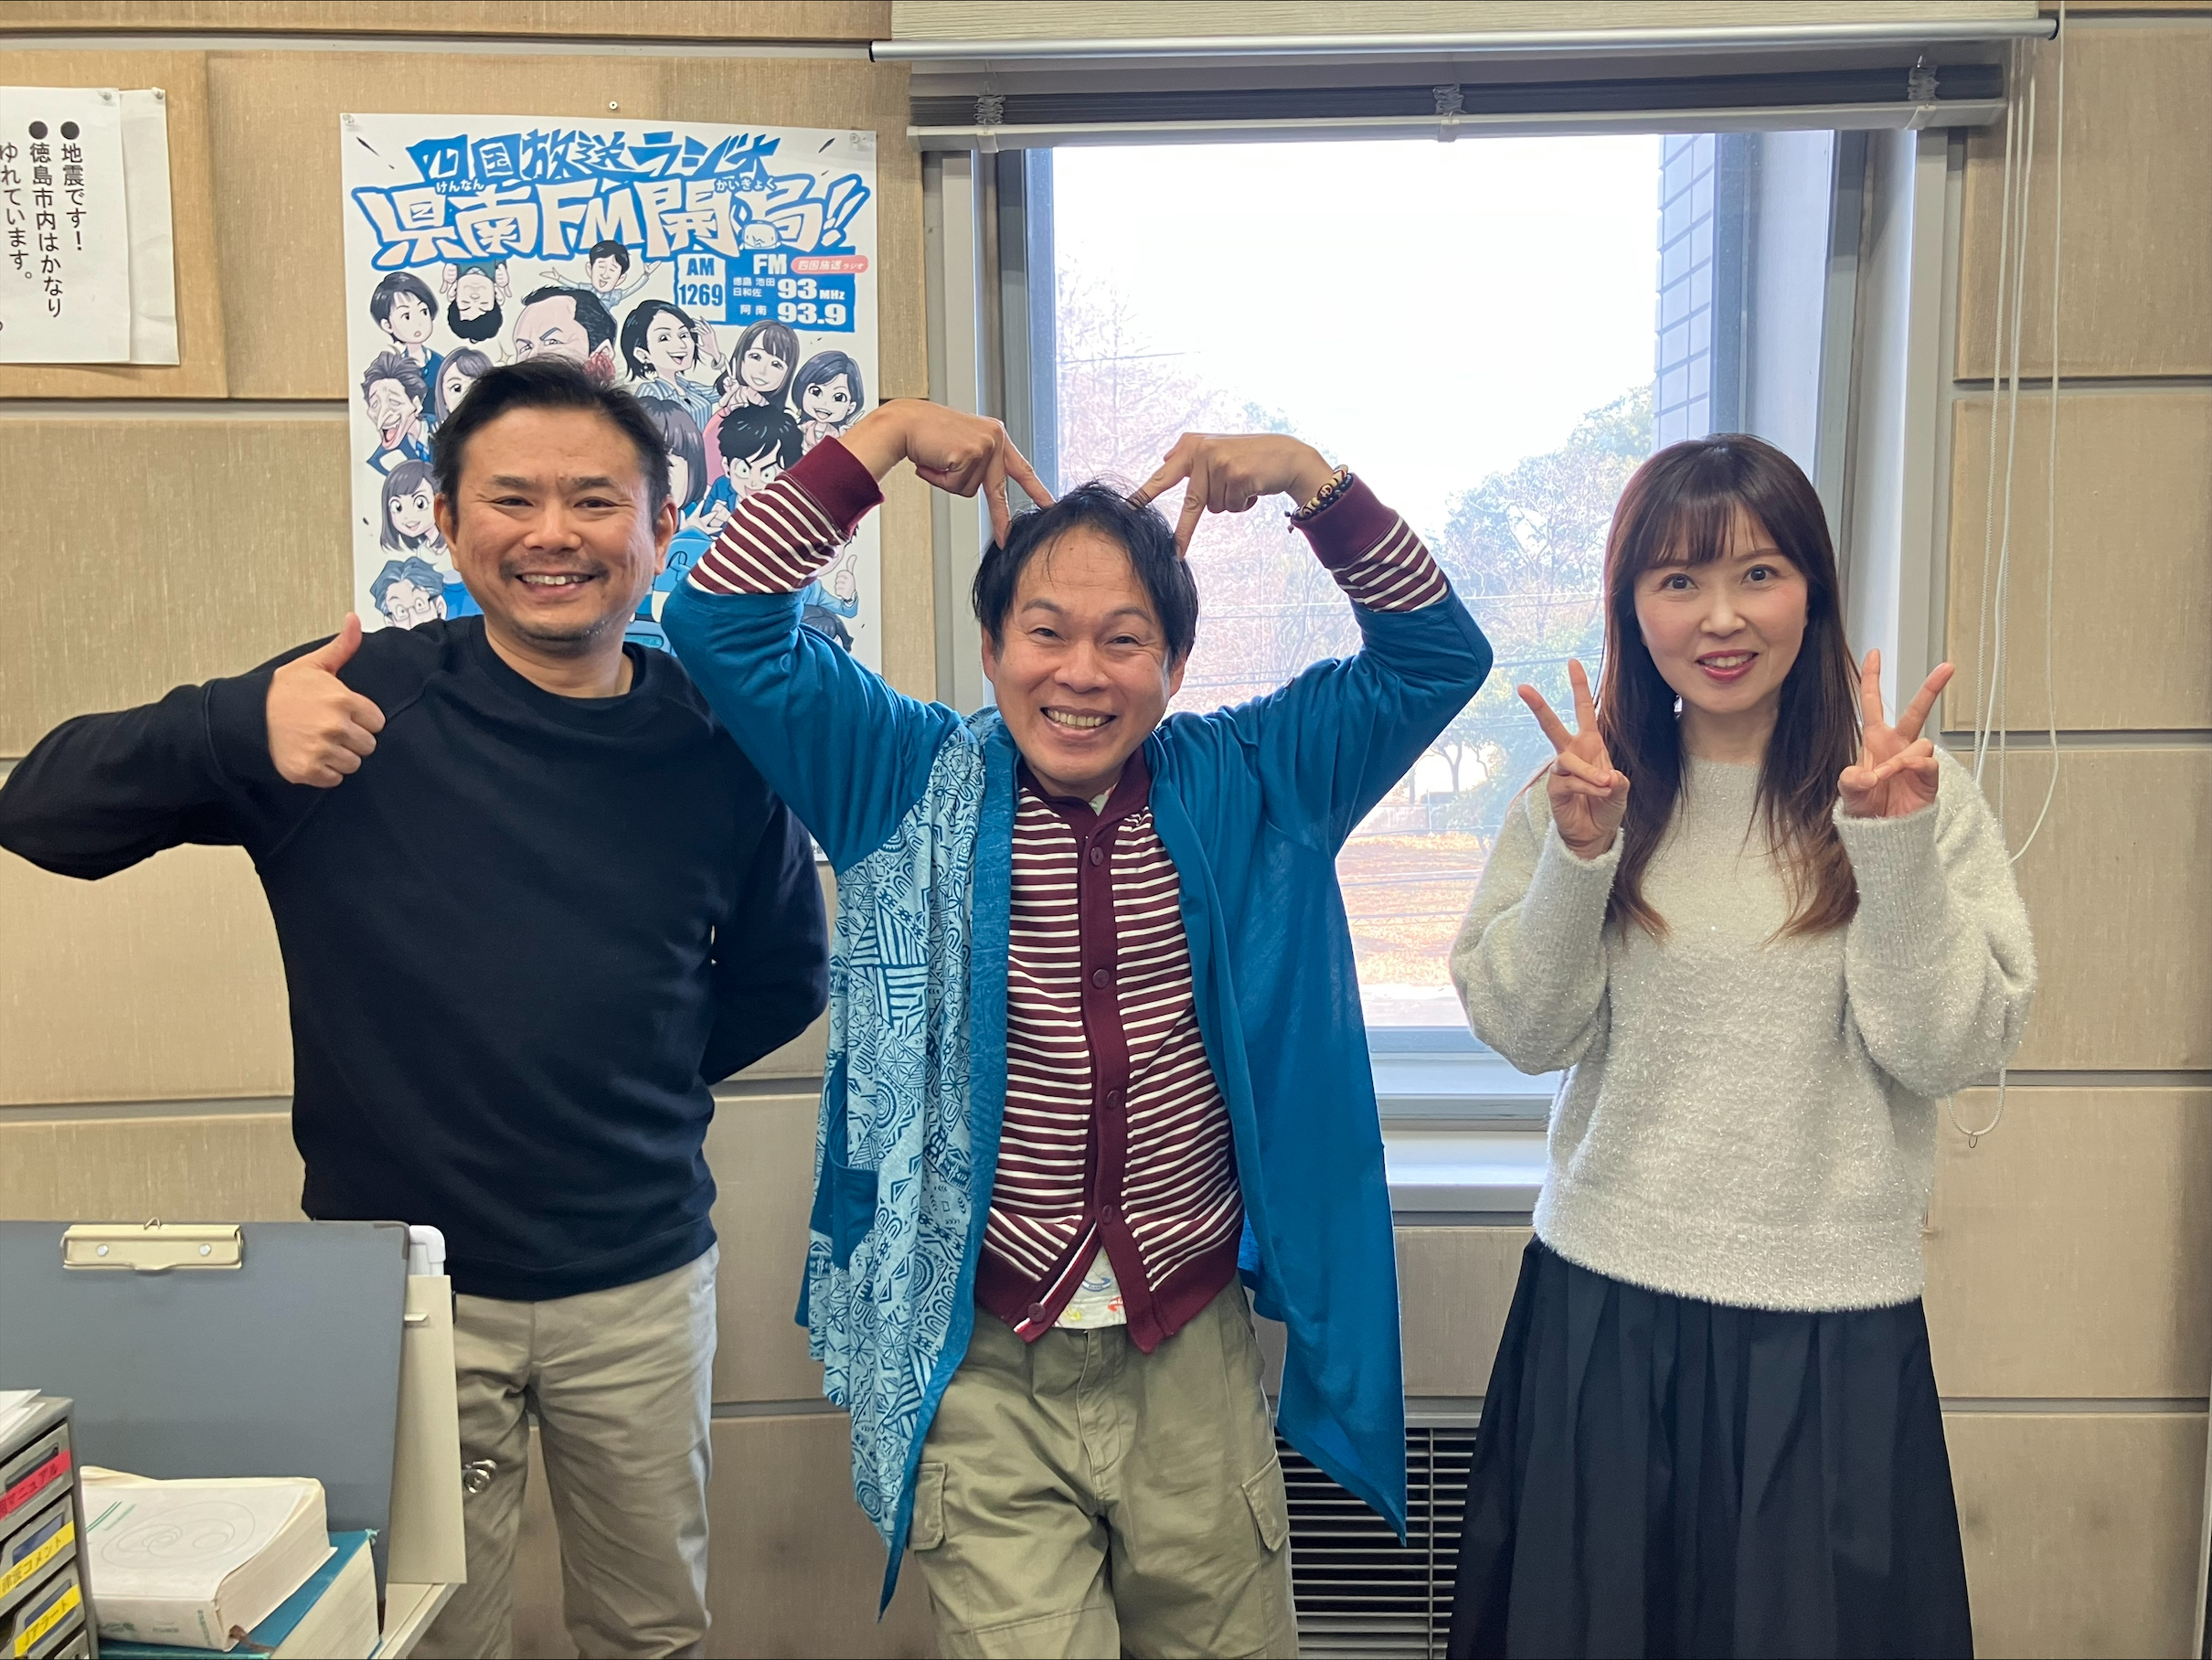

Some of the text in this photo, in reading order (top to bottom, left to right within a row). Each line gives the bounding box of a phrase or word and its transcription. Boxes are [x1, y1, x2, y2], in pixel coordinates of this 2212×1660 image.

[406, 127, 781, 179] 四国放送ラジオ
[435, 179, 486, 193] けんなん
[715, 177, 778, 192] かいきょく
[0, 142, 32, 279] ゆれています。
[29, 143, 64, 318] 徳島市内はかなり
[686, 258, 715, 276] AM
[753, 254, 787, 275] FM
[679, 283, 724, 307] 1269
[778, 278, 845, 300] 93 MHz
[778, 302, 846, 325] 93.9
